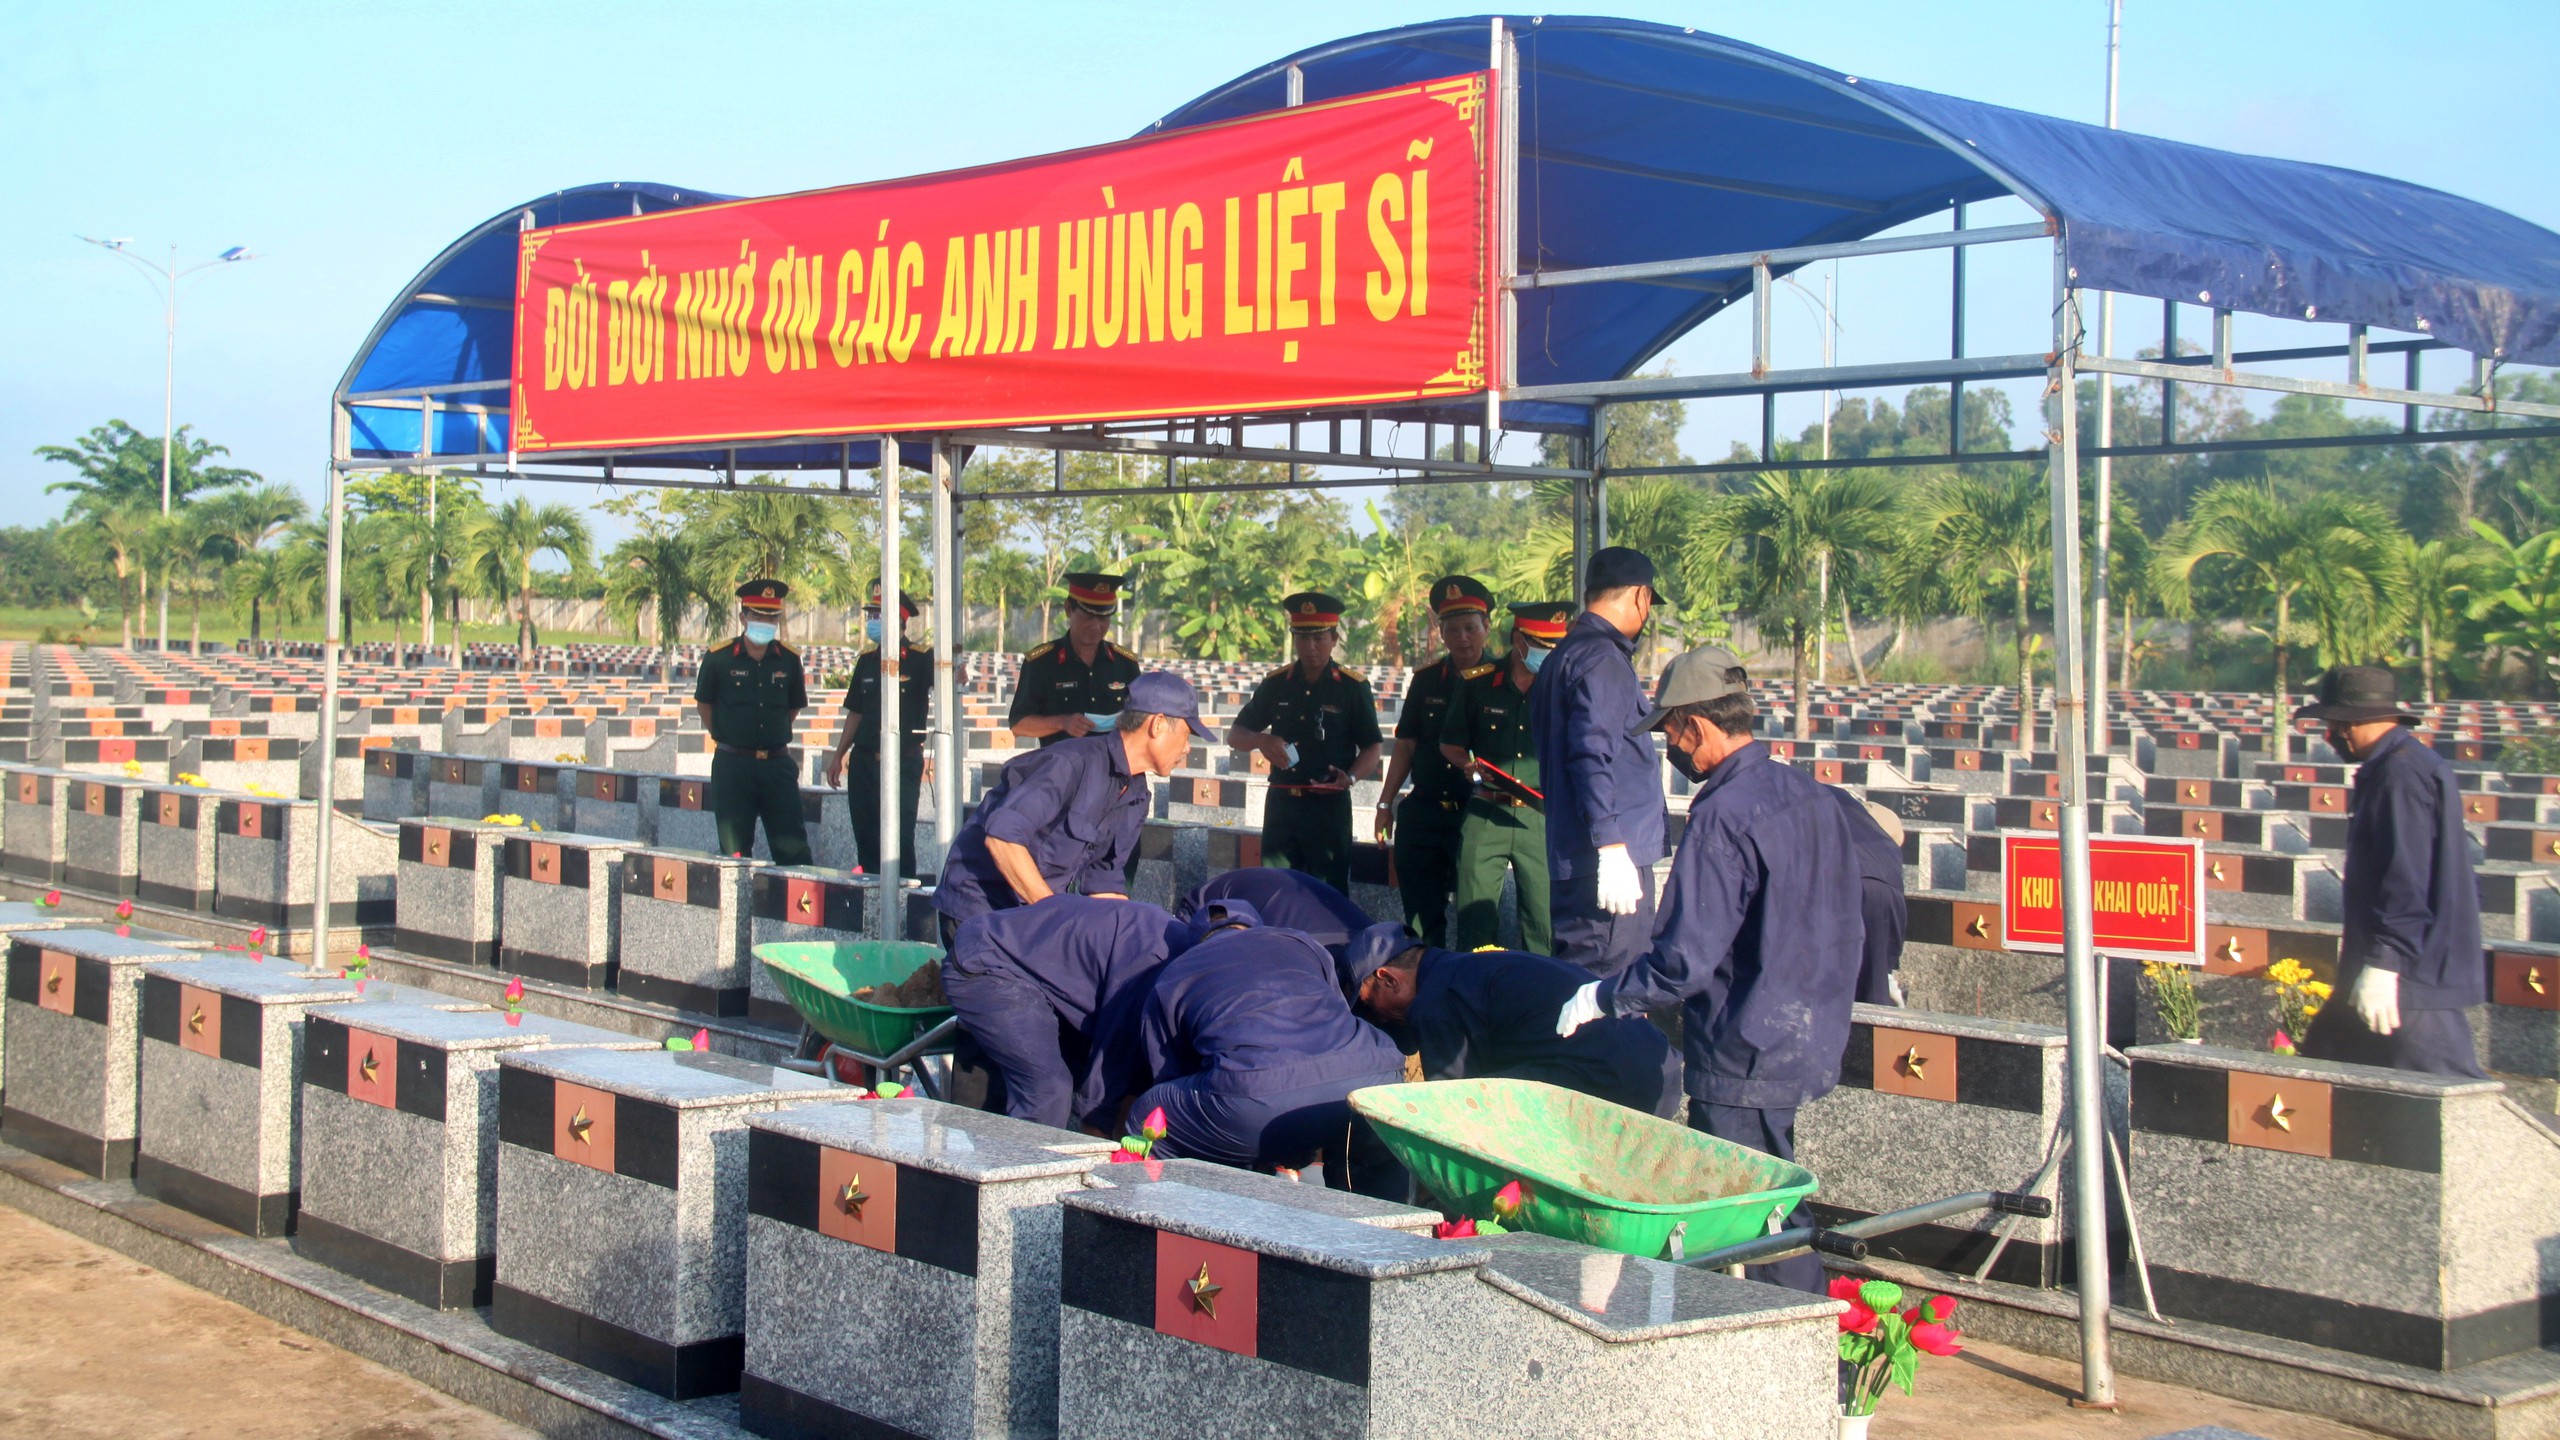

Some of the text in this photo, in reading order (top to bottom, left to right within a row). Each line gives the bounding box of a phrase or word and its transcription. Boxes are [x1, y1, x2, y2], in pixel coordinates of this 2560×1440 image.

[544, 136, 1434, 391] ĐỜI ĐỜI NHỚ ƠN CÁC ANH HÙNG LIỆT SĨ
[2021, 876, 2054, 909] KHU
[2093, 880, 2131, 914] KHAI
[2136, 876, 2180, 923] QUẬT
